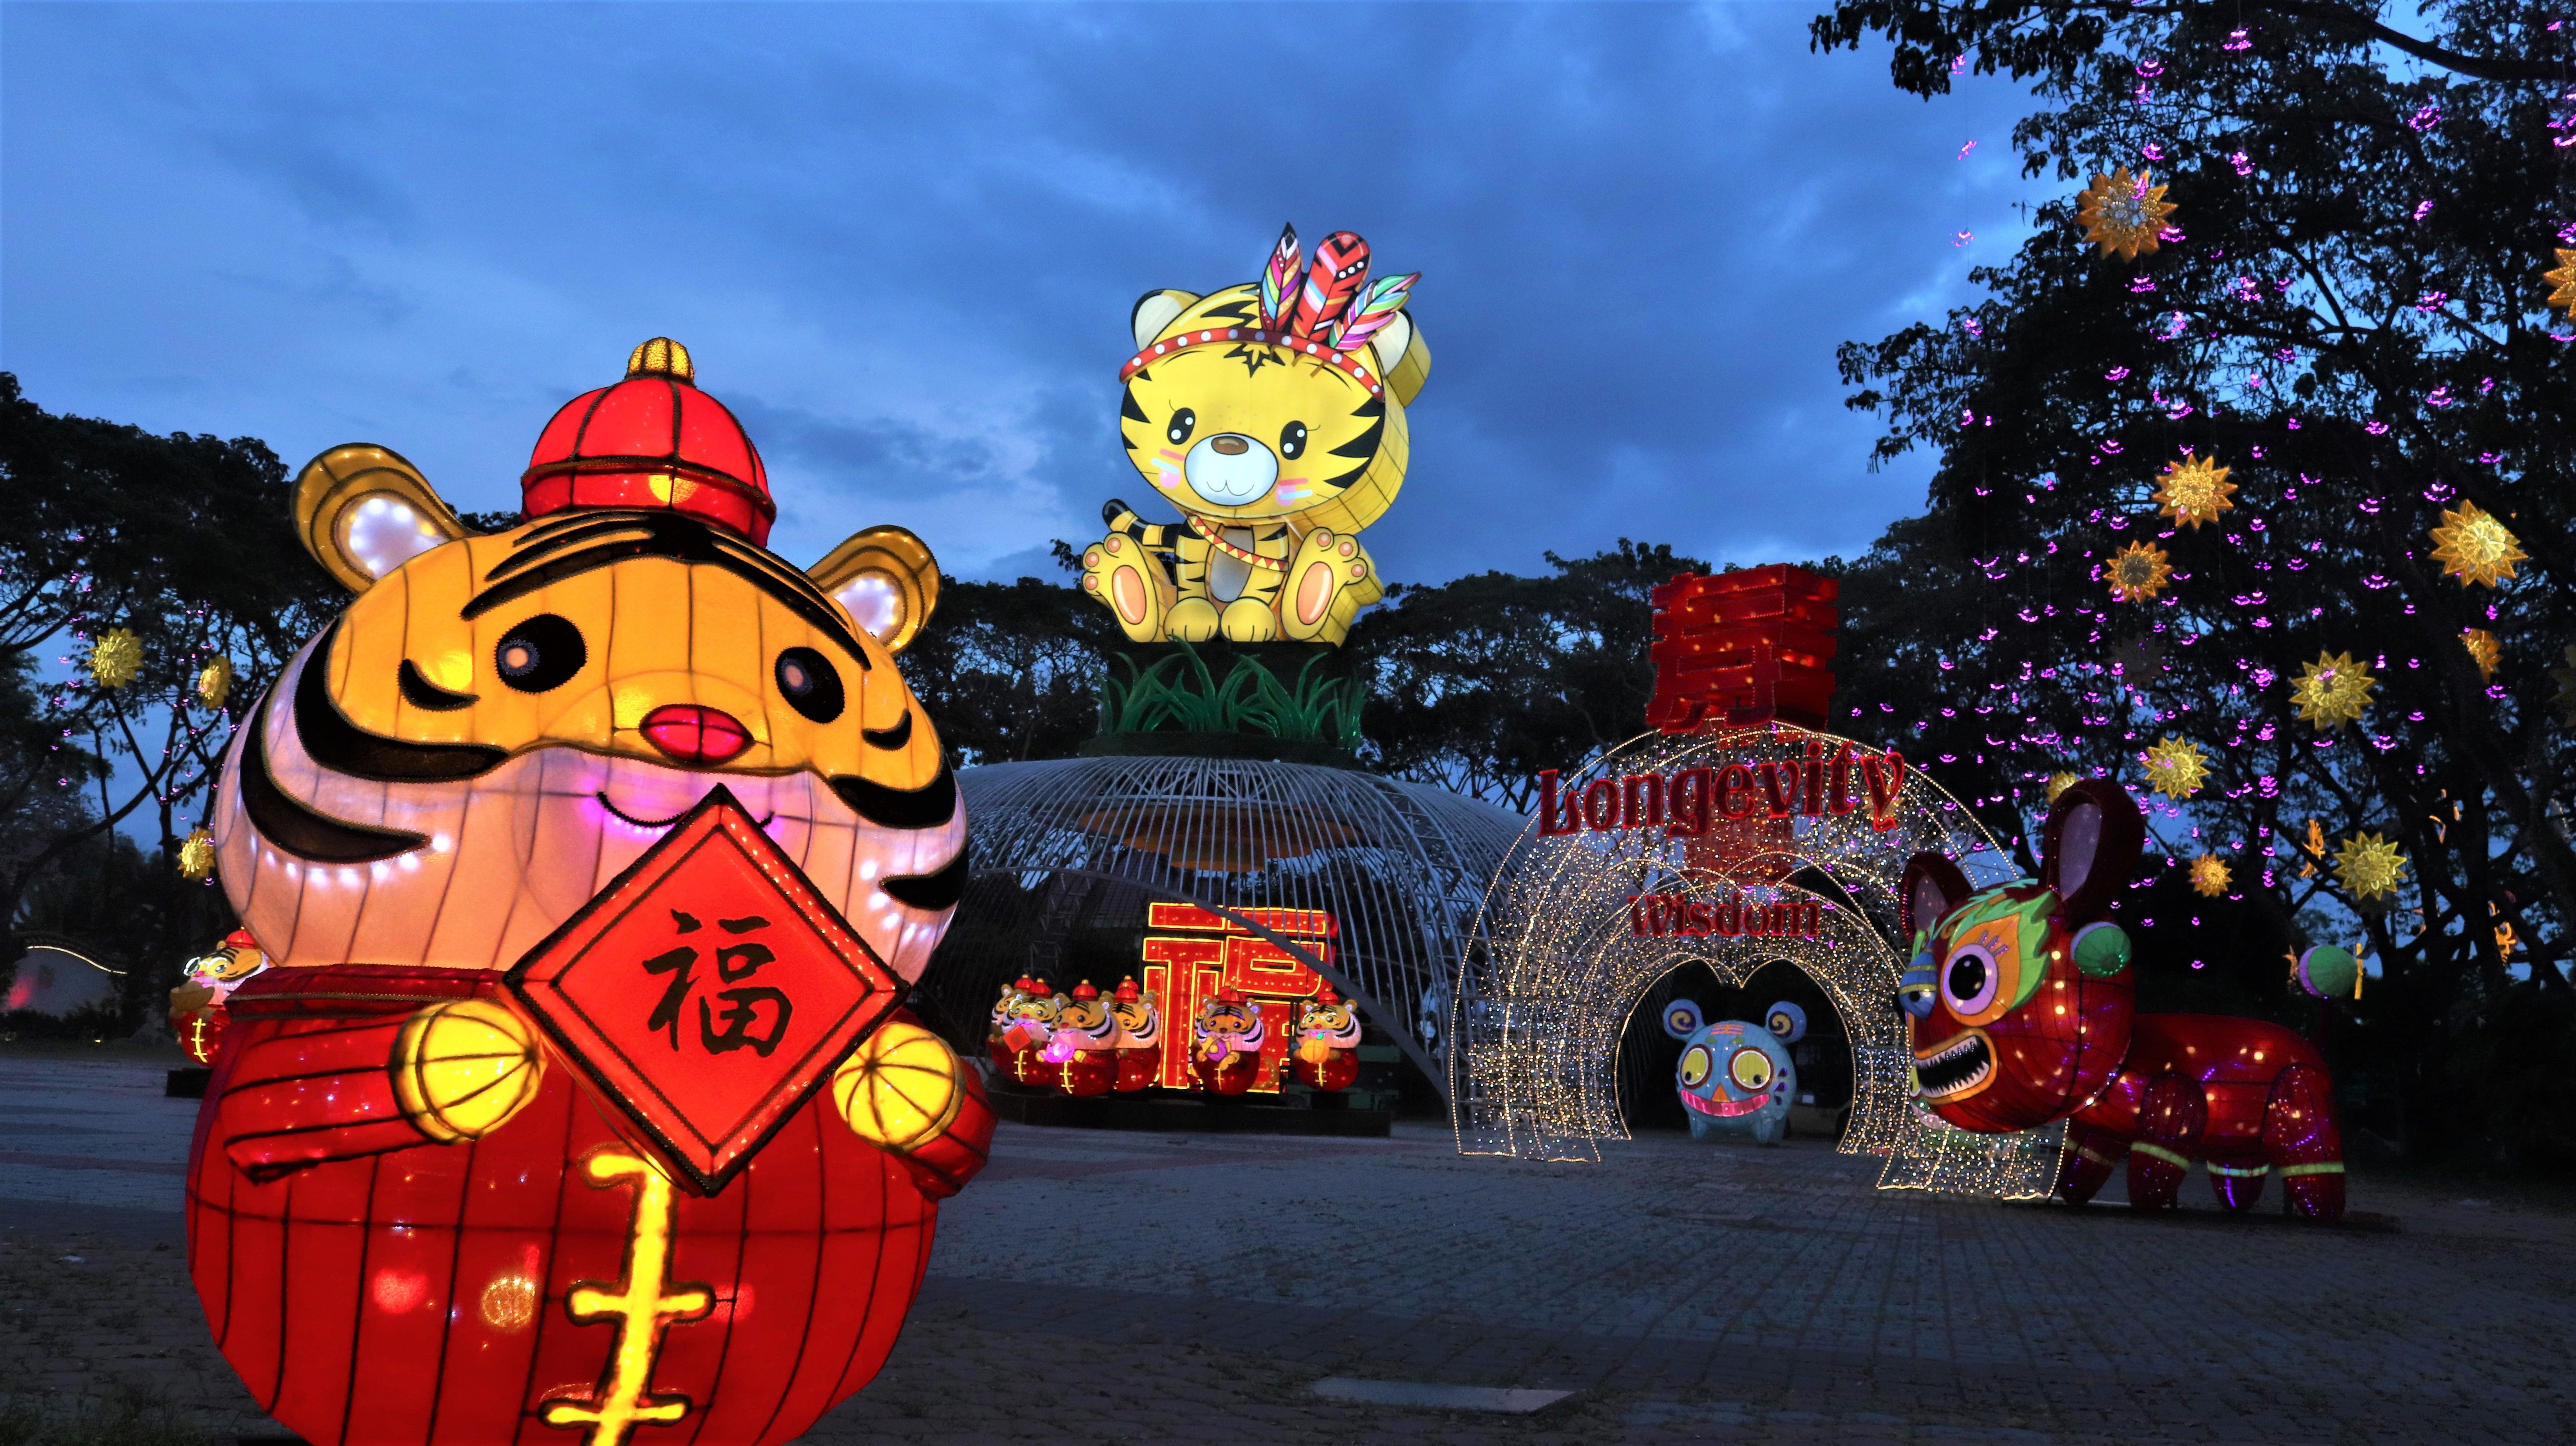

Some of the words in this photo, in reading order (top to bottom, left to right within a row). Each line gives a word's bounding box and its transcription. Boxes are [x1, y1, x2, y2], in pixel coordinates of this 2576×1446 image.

[1537, 740, 1905, 837] Longevity
[1627, 893, 1820, 937] Wisdom
[642, 909, 793, 1058] 福
